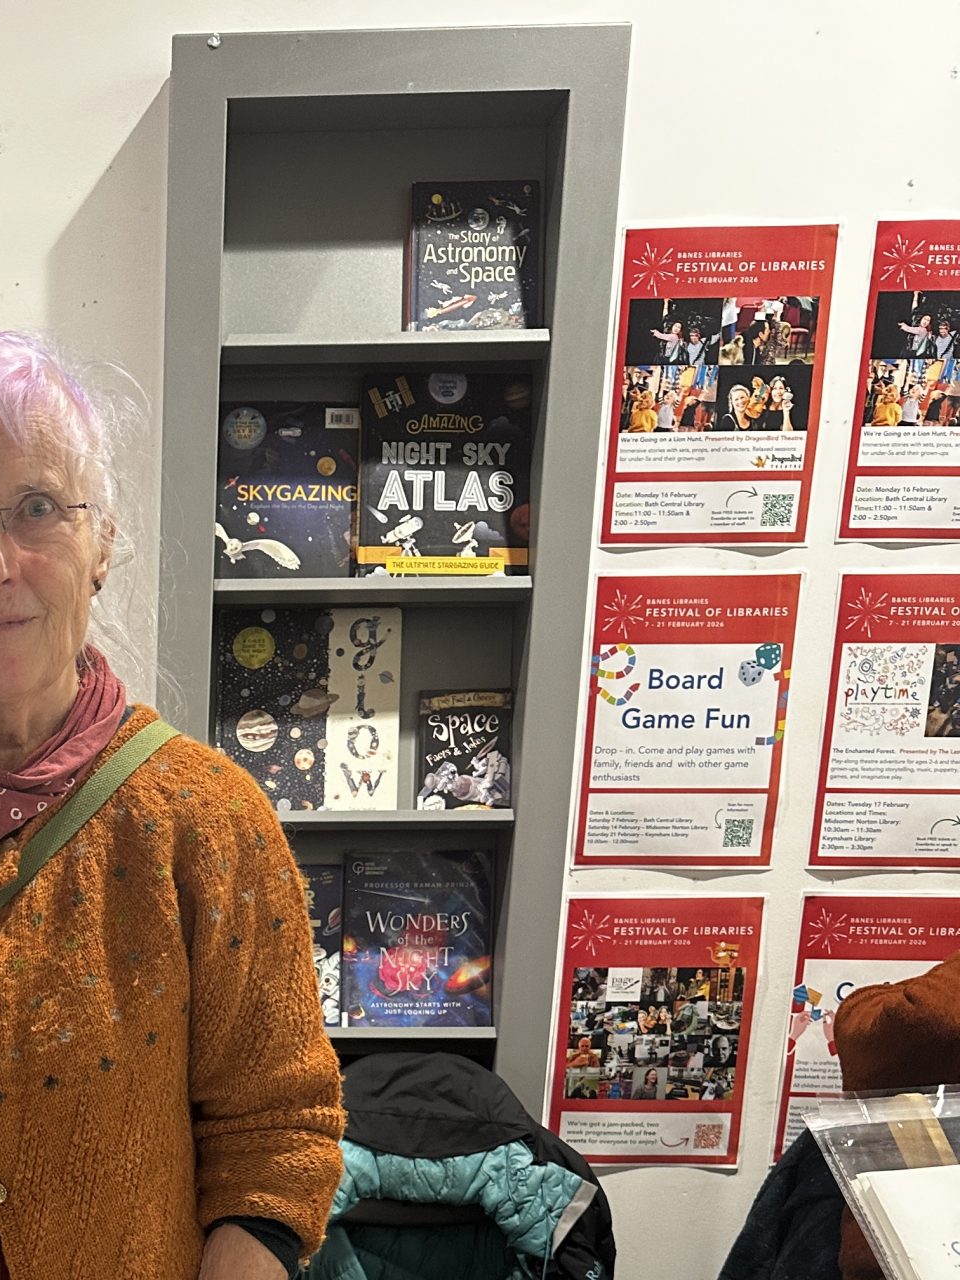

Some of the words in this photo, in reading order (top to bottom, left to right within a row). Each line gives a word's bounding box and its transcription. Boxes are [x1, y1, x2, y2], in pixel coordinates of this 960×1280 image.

[460, 230, 491, 246] Story
[492, 234, 500, 242] of
[423, 243, 527, 268] Astronomy
[446, 268, 458, 276] and
[459, 263, 516, 288] Space
[676, 262, 734, 273] FESTIVAL
[739, 262, 756, 272] OF
[762, 260, 826, 272] LIBRARIES
[406, 412, 484, 434] AMAZING
[382, 441, 452, 466] NIGHT
[462, 442, 512, 466] SKY
[237, 483, 358, 502] SKYGAZING
[377, 470, 515, 512] ATLAS
[646, 608, 700, 617] FESTIVAL
[706, 608, 722, 616] OF
[727, 607, 788, 616] LIBRARIES
[890, 606, 946, 616] FESTIVAL
[648, 667, 724, 690] Board
[844, 683, 920, 707] playtime
[622, 708, 695, 729] Game
[706, 708, 751, 729] Fun
[428, 713, 499, 748] Space
[426, 748, 452, 767] Facts
[453, 747, 462, 756] &
[463, 736, 486, 754] Jokes
[594, 746, 617, 756] Drop
[638, 746, 664, 754] Come
[667, 746, 684, 754] and
[685, 746, 704, 756] play
[706, 747, 735, 756] games
[737, 746, 756, 754] with
[594, 760, 622, 770] family,
[624, 760, 654, 768] friends
[656, 760, 672, 768] and
[678, 760, 696, 768] with
[698, 760, 722, 768] other
[724, 761, 749, 770] game
[592, 773, 640, 782] enthusiasts
[366, 911, 471, 936] WONDERS
[614, 926, 668, 936] FESTIVAL
[673, 926, 689, 936] OF
[694, 926, 754, 936] LIBRARIES
[850, 926, 904, 935] FESTIVAL
[908, 927, 924, 936] OF
[398, 934, 410, 948] of
[415, 934, 434, 945] the
[378, 946, 454, 969] NIGHT
[389, 972, 438, 998] SKY
